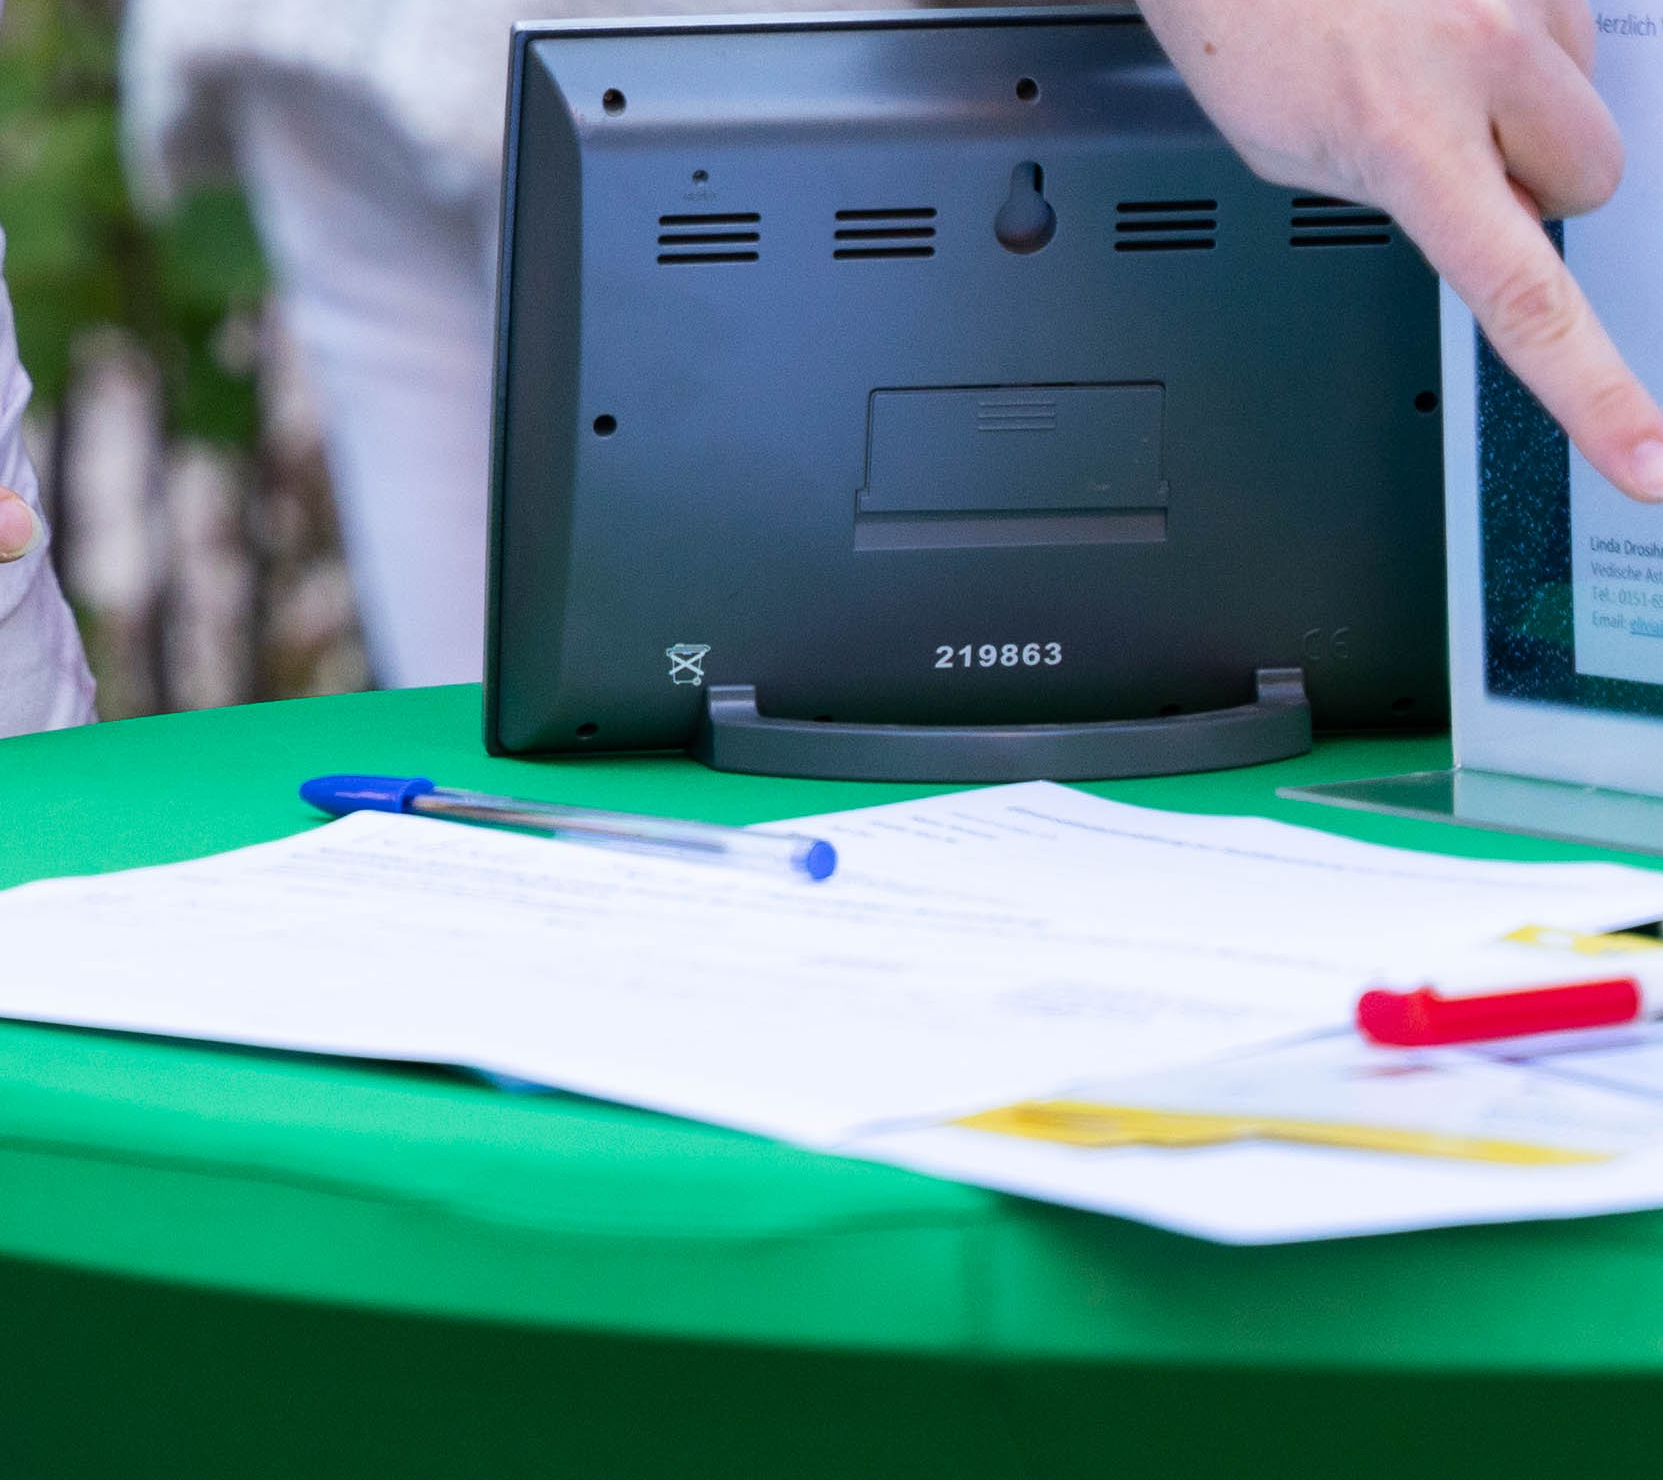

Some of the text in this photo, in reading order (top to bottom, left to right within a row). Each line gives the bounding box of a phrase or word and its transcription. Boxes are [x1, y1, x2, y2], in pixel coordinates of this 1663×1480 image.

[1589, 535, 1622, 555] Linda
[1590, 560, 1643, 582] Vedische
[934, 642, 1063, 669] 219863
